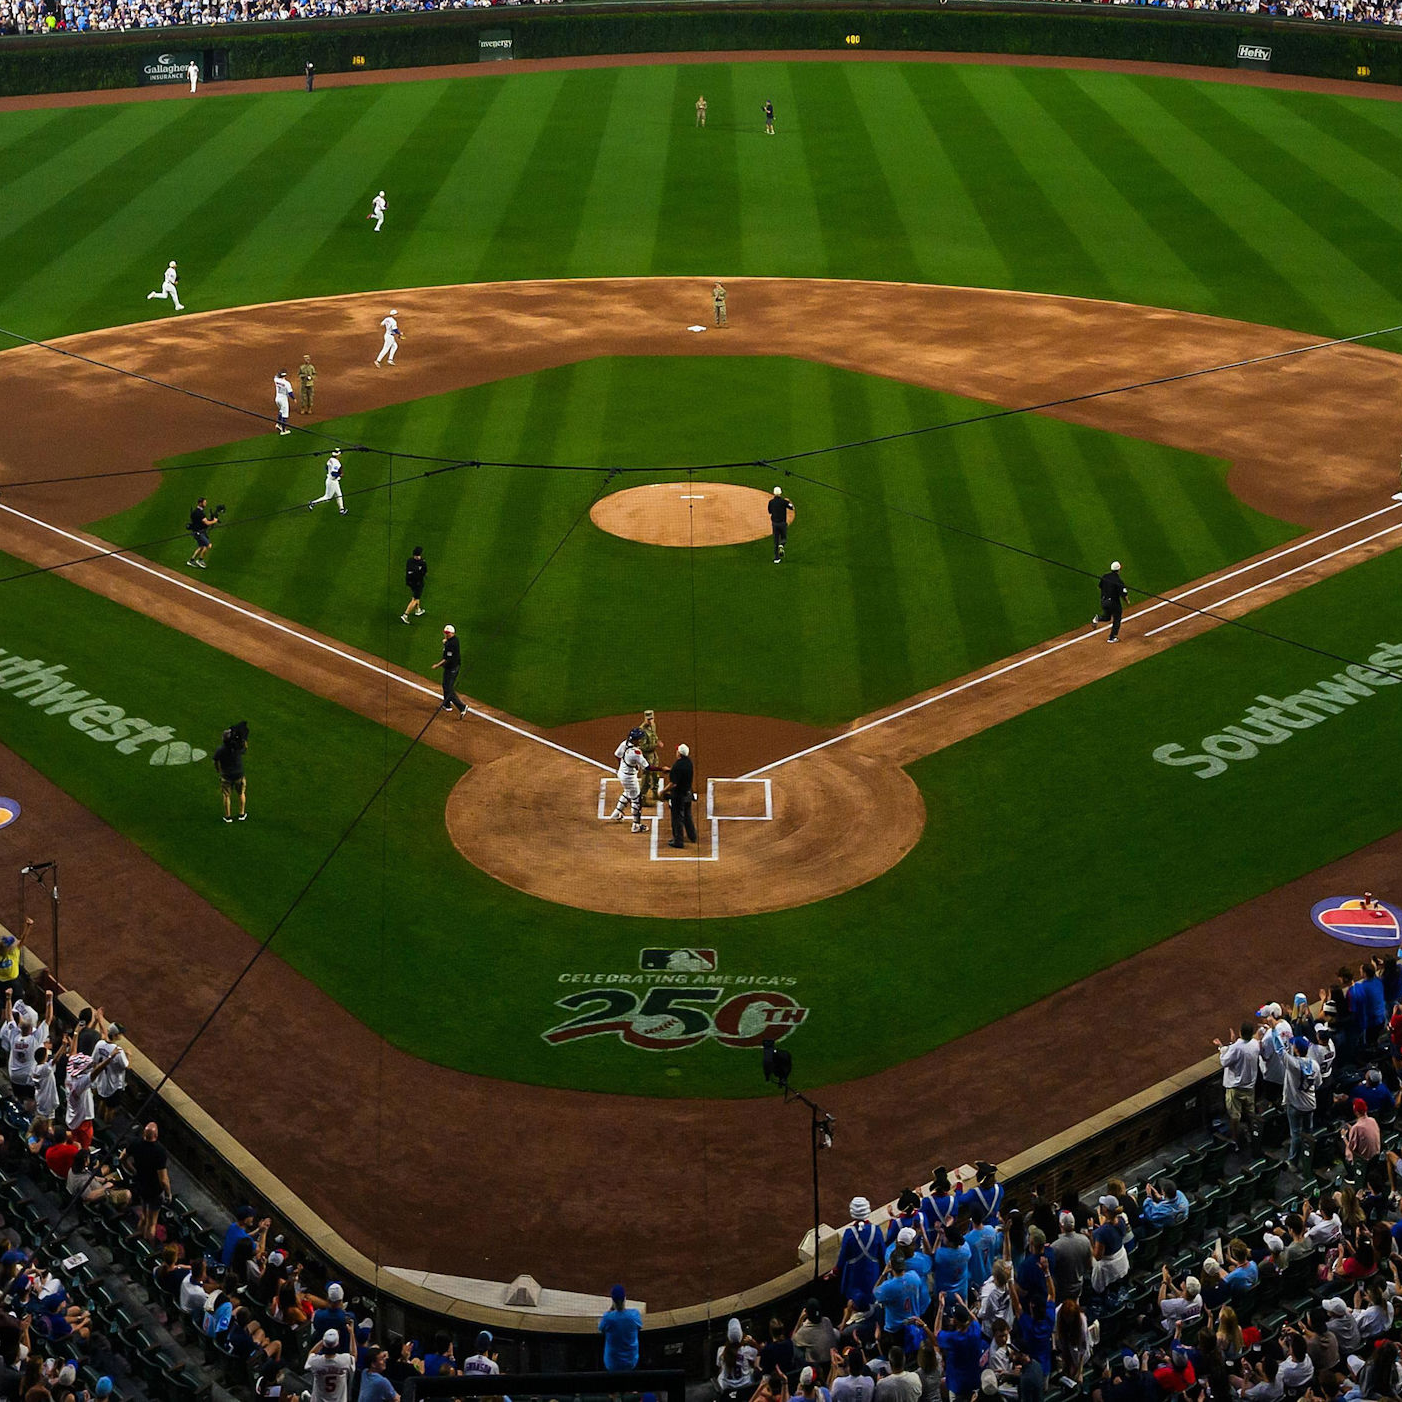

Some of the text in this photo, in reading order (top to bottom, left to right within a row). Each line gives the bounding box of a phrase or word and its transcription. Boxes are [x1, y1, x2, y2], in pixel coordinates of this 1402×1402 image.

[846, 34, 860, 45] 400
[1239, 47, 1269, 60] Hefty
[144, 64, 189, 75] Gallagher
[150, 73, 183, 81] INSURANCE
[558, 973, 797, 986] CELEBRATING AMERICA'S
